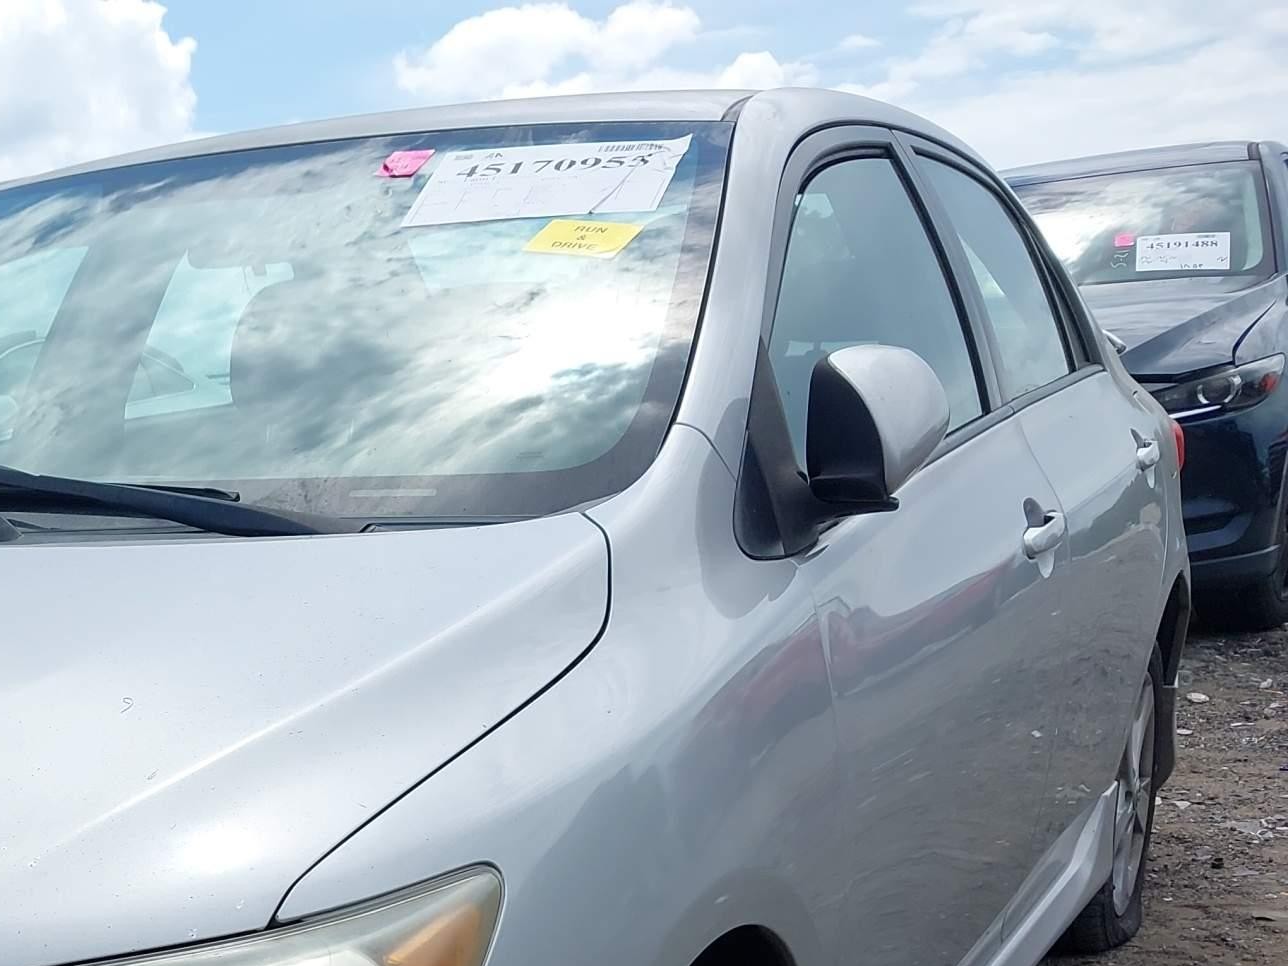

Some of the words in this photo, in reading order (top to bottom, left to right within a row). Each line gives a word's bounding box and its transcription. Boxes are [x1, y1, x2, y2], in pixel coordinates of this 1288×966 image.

[573, 225, 608, 234] RUN
[551, 241, 598, 250] DRIVE
[1146, 240, 1219, 250] 45191488
